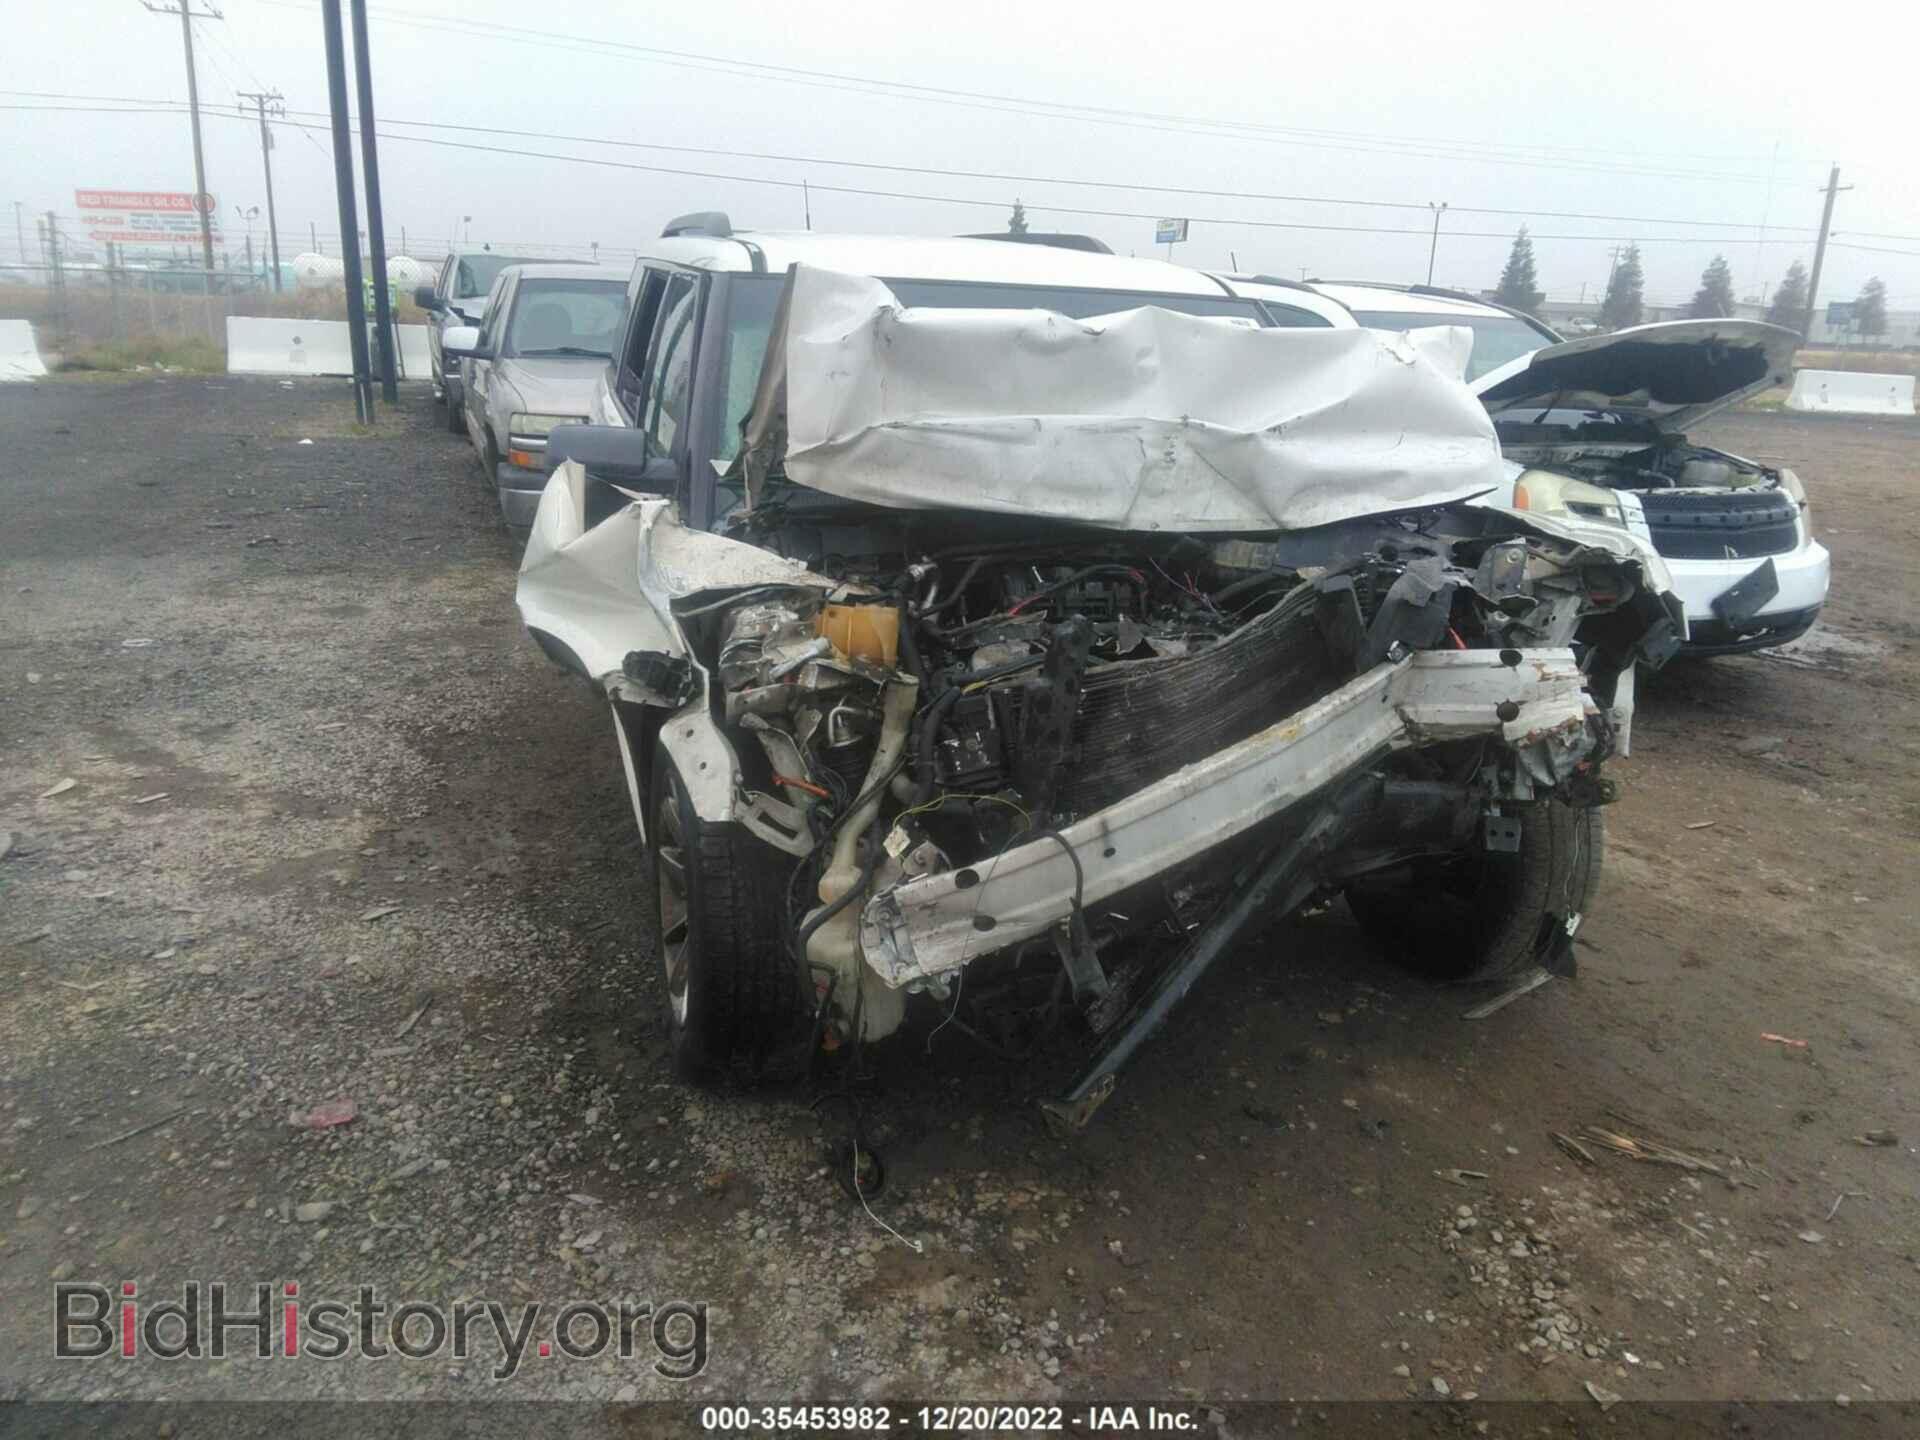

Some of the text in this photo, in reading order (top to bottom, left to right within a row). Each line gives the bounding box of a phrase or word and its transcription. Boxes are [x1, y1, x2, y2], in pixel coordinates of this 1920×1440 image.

[79, 194, 100, 206] RED
[102, 194, 151, 208] TRIANGLE
[152, 196, 169, 208] OIL
